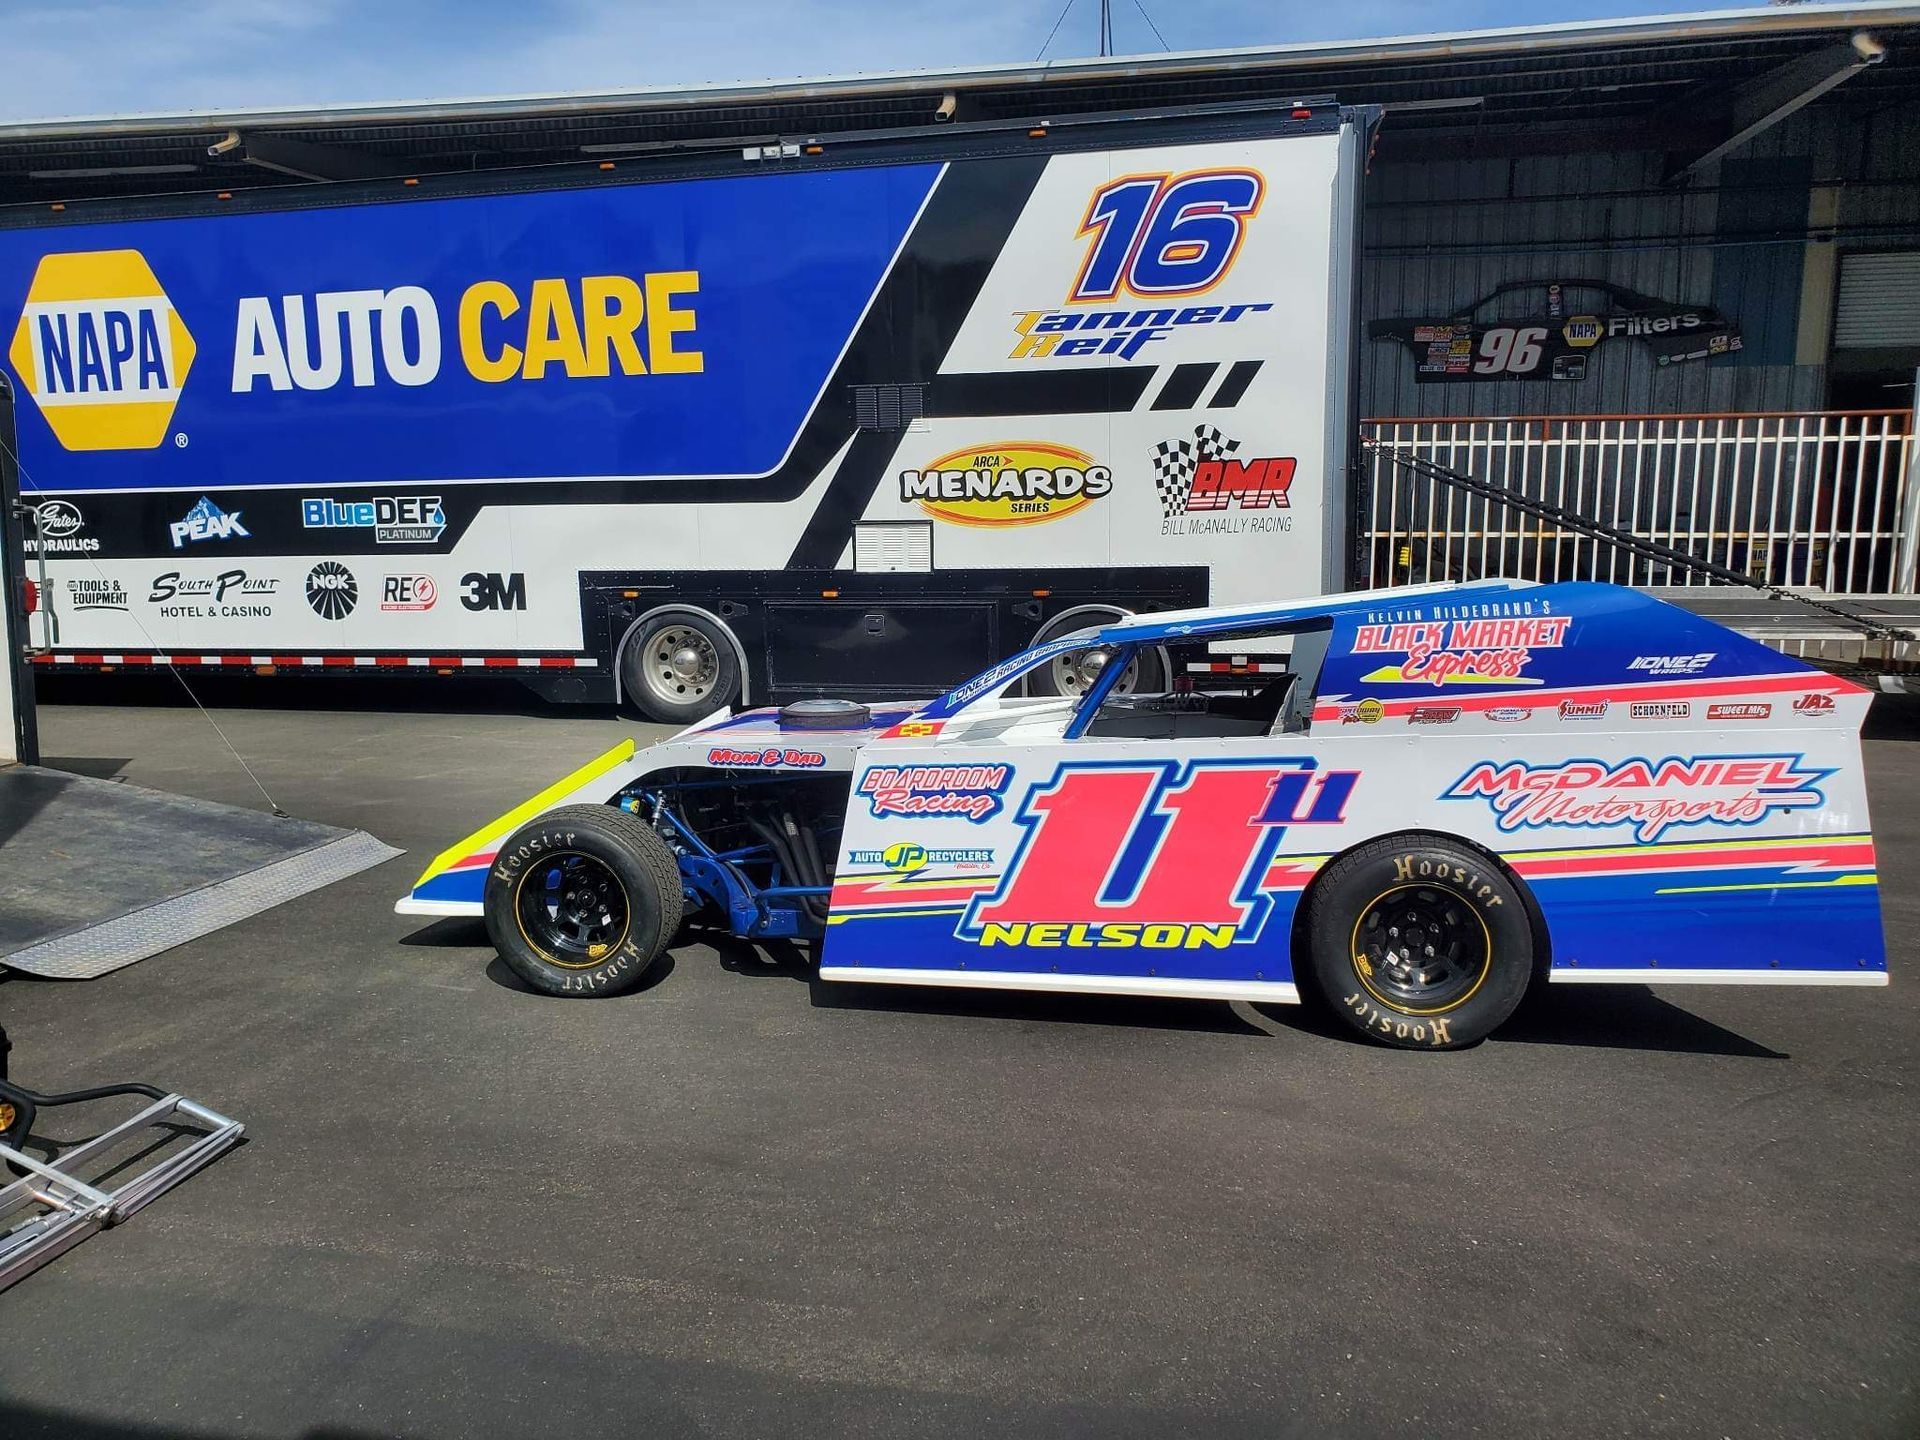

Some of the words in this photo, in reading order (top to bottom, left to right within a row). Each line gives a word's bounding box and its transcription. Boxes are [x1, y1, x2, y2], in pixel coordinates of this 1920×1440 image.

[1068, 170, 1265, 302] 16
[232, 286, 441, 392] AUTO
[459, 271, 704, 382] CARE
[1011, 303, 1274, 336] Tanner
[1569, 323, 1597, 339] NAPA
[1608, 314, 1700, 336] Filters
[38, 308, 169, 393] NAPA
[1008, 327, 1175, 361] Reif
[1473, 328, 1549, 374] 96
[973, 455, 1000, 467] ARCA
[901, 465, 1113, 502] MENARDS
[1186, 457, 1298, 511] BMR
[41, 505, 80, 532] Gates
[1011, 503, 1049, 513] SERIES
[169, 512, 249, 548] PEAK
[379, 528, 432, 540] PLATINUM
[1161, 520, 1185, 535] BILL
[1188, 518, 1249, 534] McANALLY
[1250, 516, 1293, 533] RACING
[78, 580, 109, 592] TOOLS
[113, 580, 121, 591] &
[312, 574, 351, 590] NGK
[459, 572, 527, 611] 3M
[73, 592, 128, 604] EQUIPMENT
[160, 606, 203, 617] HOTEL
[208, 606, 217, 617] &
[221, 606, 272, 617] CASINO
[1368, 609, 1421, 623] KELVIN
[1434, 598, 1551, 619] HILDEBRAND'S
[1354, 624, 1446, 651] BLACK
[1450, 618, 1570, 649] MARKET
[996, 653, 1034, 679] RACING
[1400, 644, 1531, 685] Express
[1633, 704, 1688, 716] SCHOENFELD
[1717, 705, 1746, 715] SWEET
[1793, 694, 1835, 709] JAZ
[762, 749, 781, 765] &
[863, 767, 1007, 790] BOARDROOM
[874, 788, 994, 818] Racing
[1247, 770, 1362, 827] 11
[1499, 784, 1795, 838] Motorsports
[855, 851, 882, 862] AUTO
[885, 847, 925, 867] JP
[929, 850, 989, 862] RECYCLERS
[968, 762, 1292, 928] 11
[495, 830, 576, 889] Hoosier
[1392, 854, 1503, 907] Hoosier
[979, 923, 1239, 949] NELSON
[1344, 993, 1453, 1046] Hoosier
